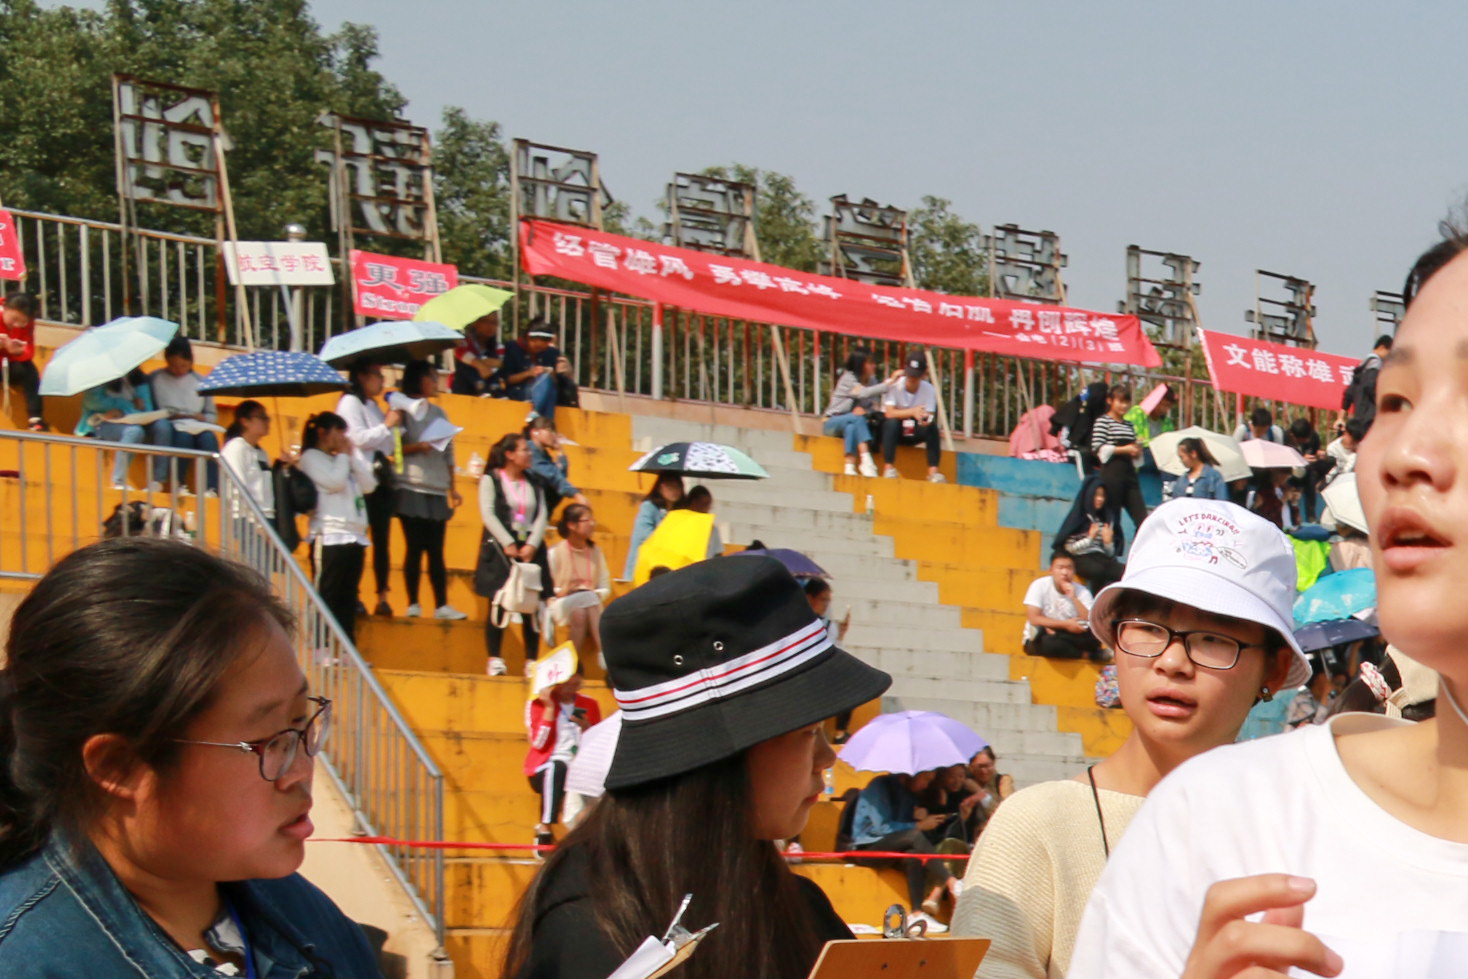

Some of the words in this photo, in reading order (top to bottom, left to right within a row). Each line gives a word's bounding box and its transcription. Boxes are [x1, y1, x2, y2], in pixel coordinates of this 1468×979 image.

[554, 232, 695, 281] 经管雄风
[1222, 343, 1336, 383] 文能称雄
